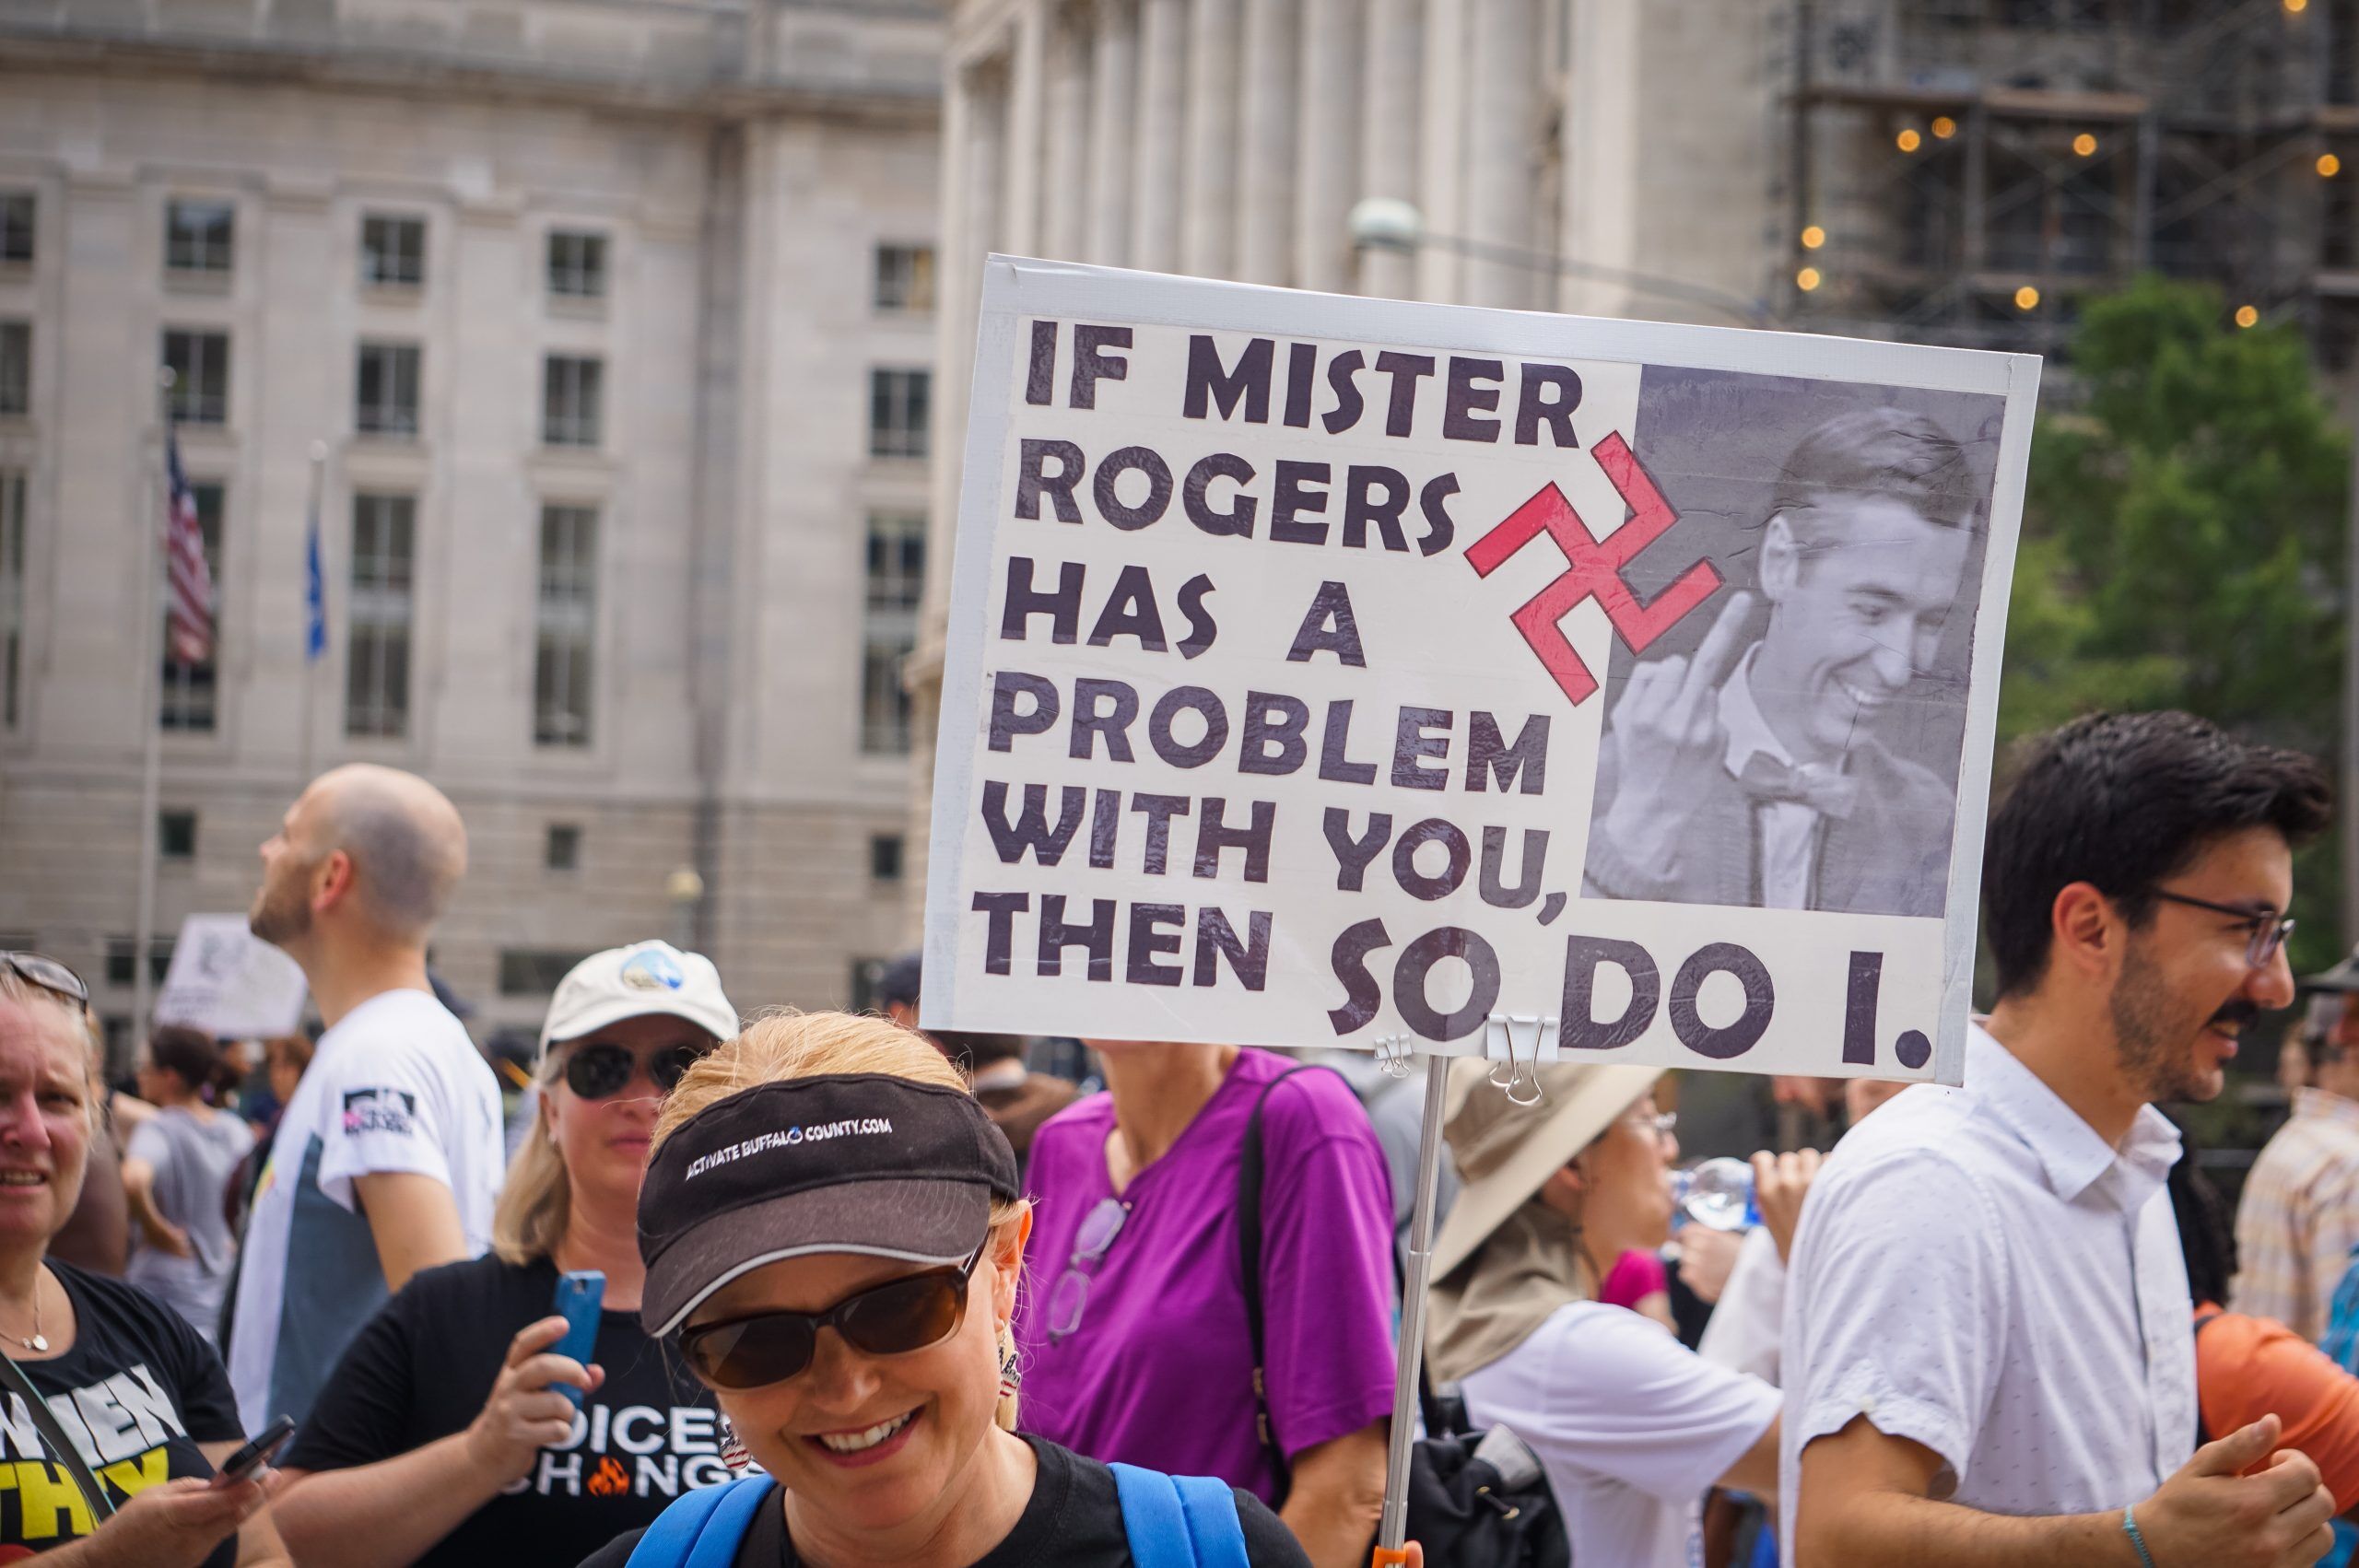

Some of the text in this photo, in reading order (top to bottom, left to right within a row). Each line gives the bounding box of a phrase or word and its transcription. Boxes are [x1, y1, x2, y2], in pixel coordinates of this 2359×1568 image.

[1026, 320, 1582, 449] IF MISTER
[1015, 439, 1461, 557] ROGERS
[1001, 556, 1367, 668] HAS A
[988, 671, 1551, 795] PROBLEM
[981, 780, 1567, 926] WITH YOU,
[971, 891, 1931, 1069] THEN SO DO I.
[741, 1126, 804, 1158] BUFFALO
[804, 1117, 893, 1141] COUNTY.COM
